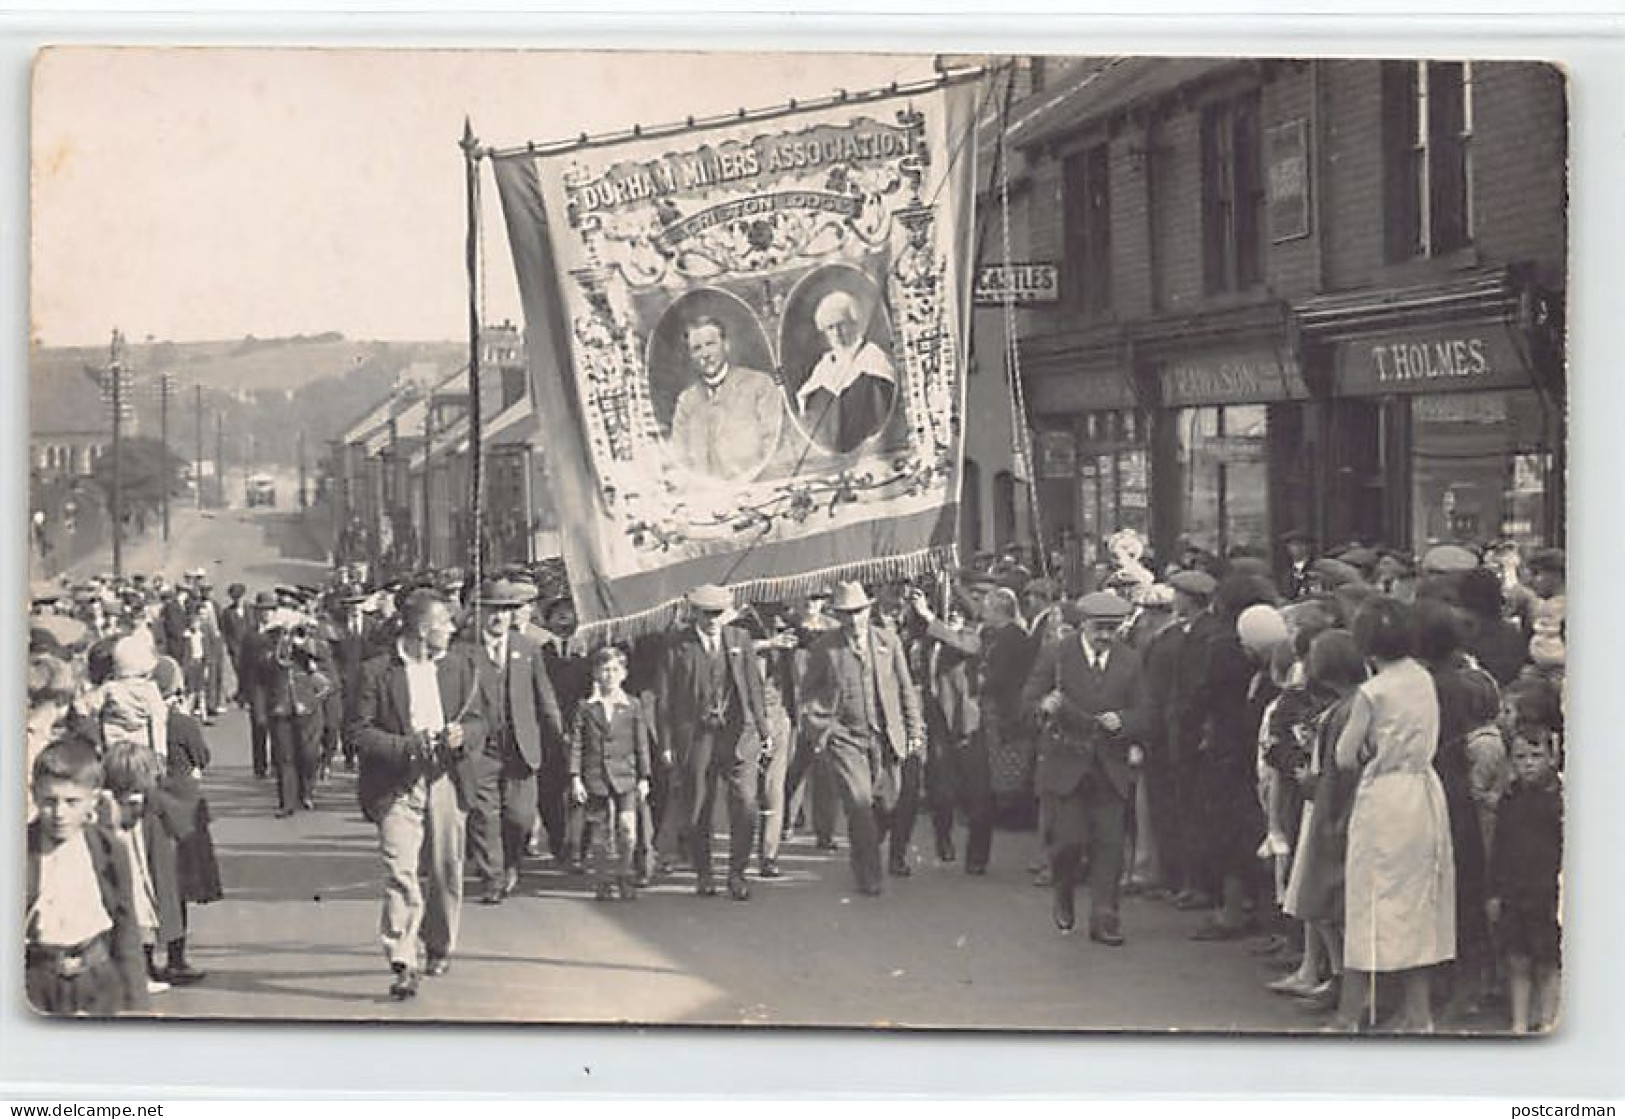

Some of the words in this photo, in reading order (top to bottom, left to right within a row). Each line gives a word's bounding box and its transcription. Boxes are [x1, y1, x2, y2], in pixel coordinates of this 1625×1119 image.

[584, 164, 676, 210] DURHAM
[770, 131, 911, 169] ASSOCIATION
[977, 267, 1054, 290] CATLES
